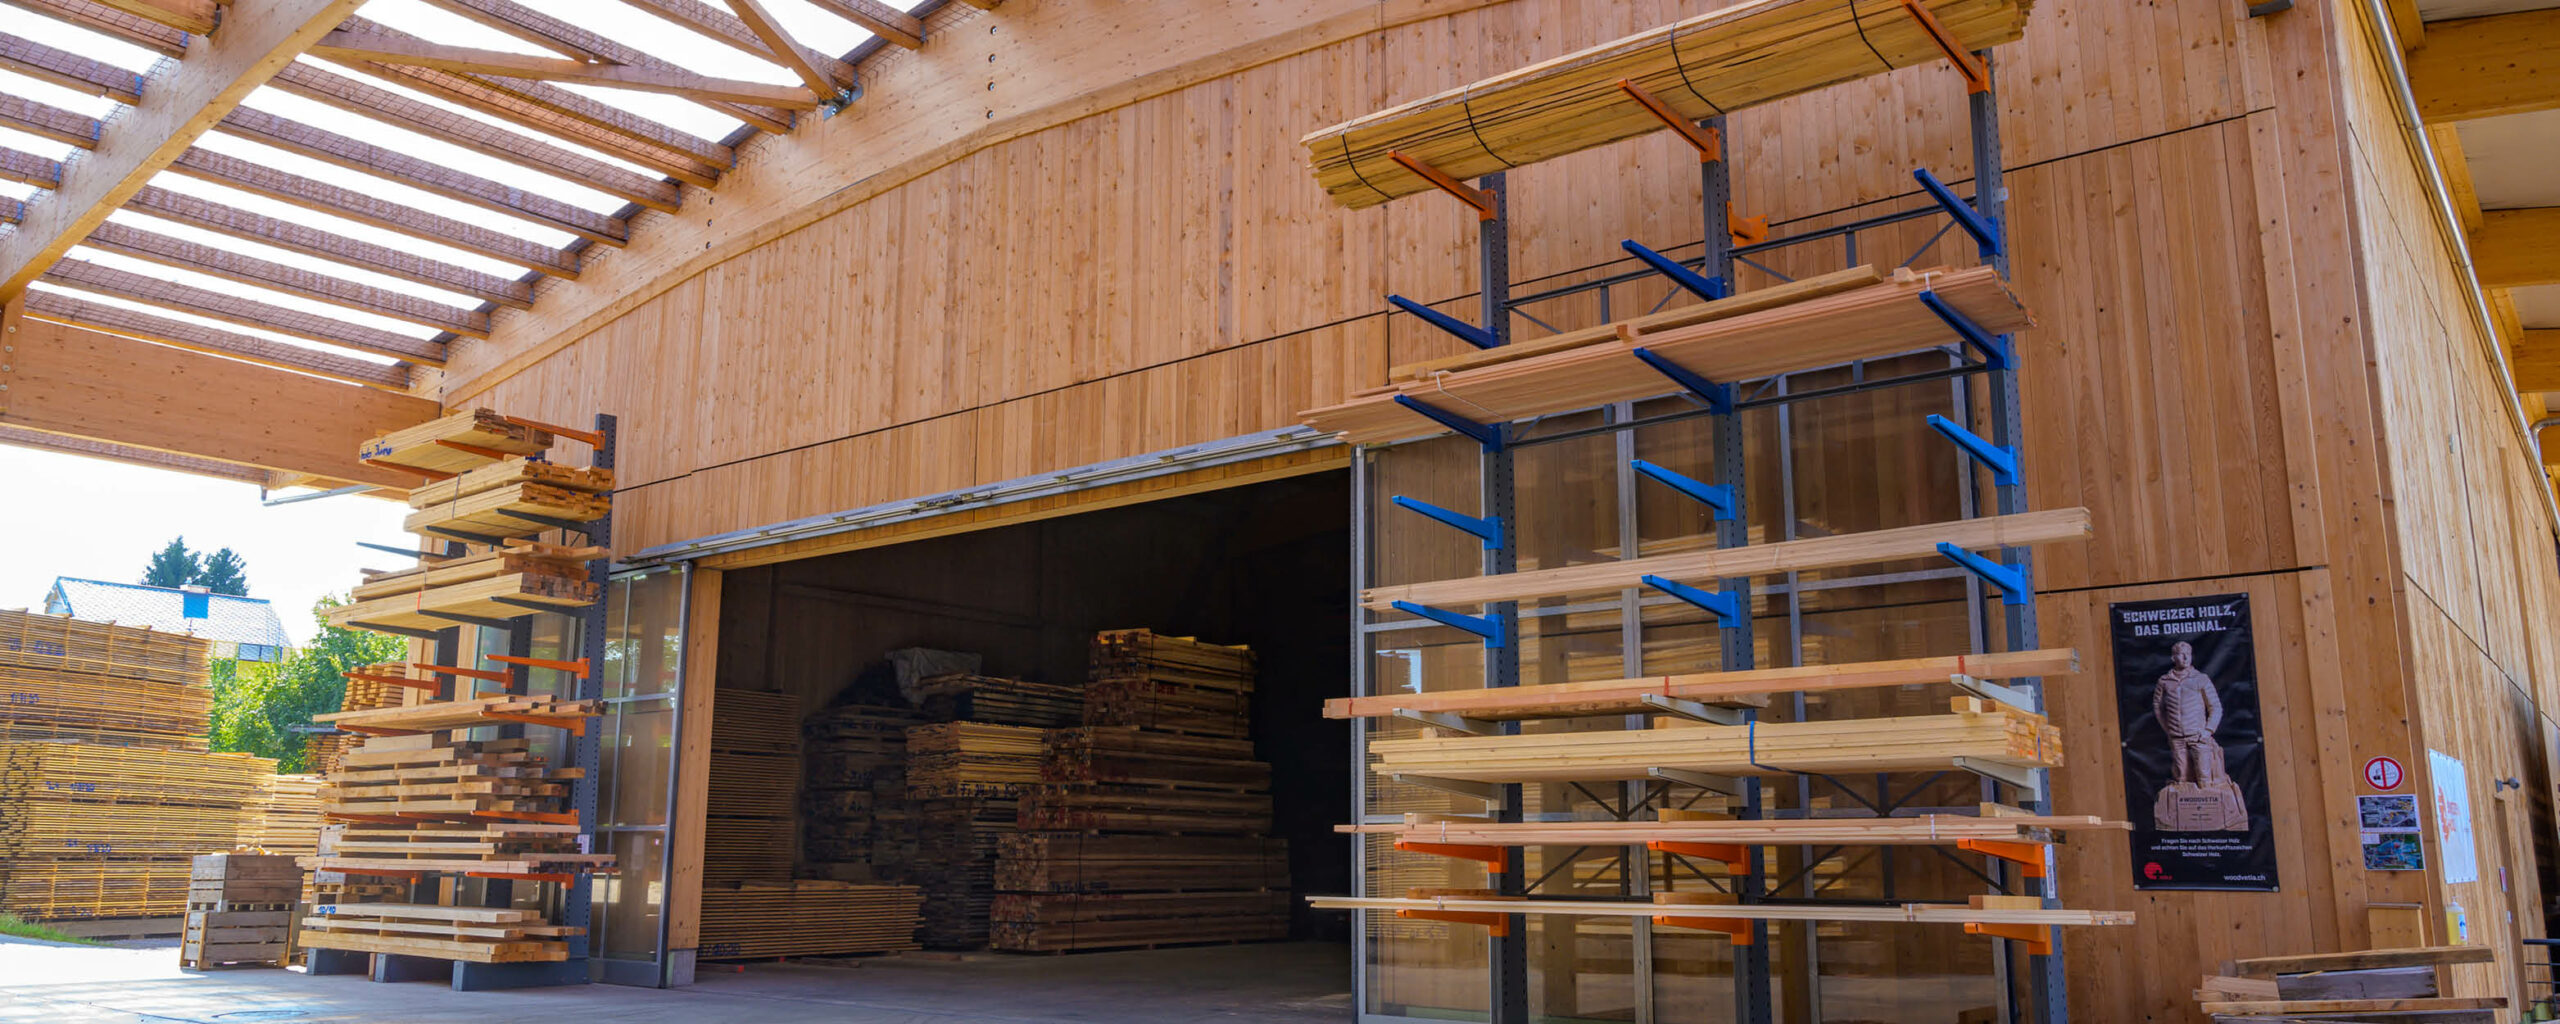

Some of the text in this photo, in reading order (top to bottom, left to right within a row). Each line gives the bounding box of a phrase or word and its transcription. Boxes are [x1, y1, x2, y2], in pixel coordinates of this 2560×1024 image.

[2123, 604, 2236, 623] SCHWEIZER HOLZ,
[2135, 620, 2226, 636] DAS ORIGINAL.
